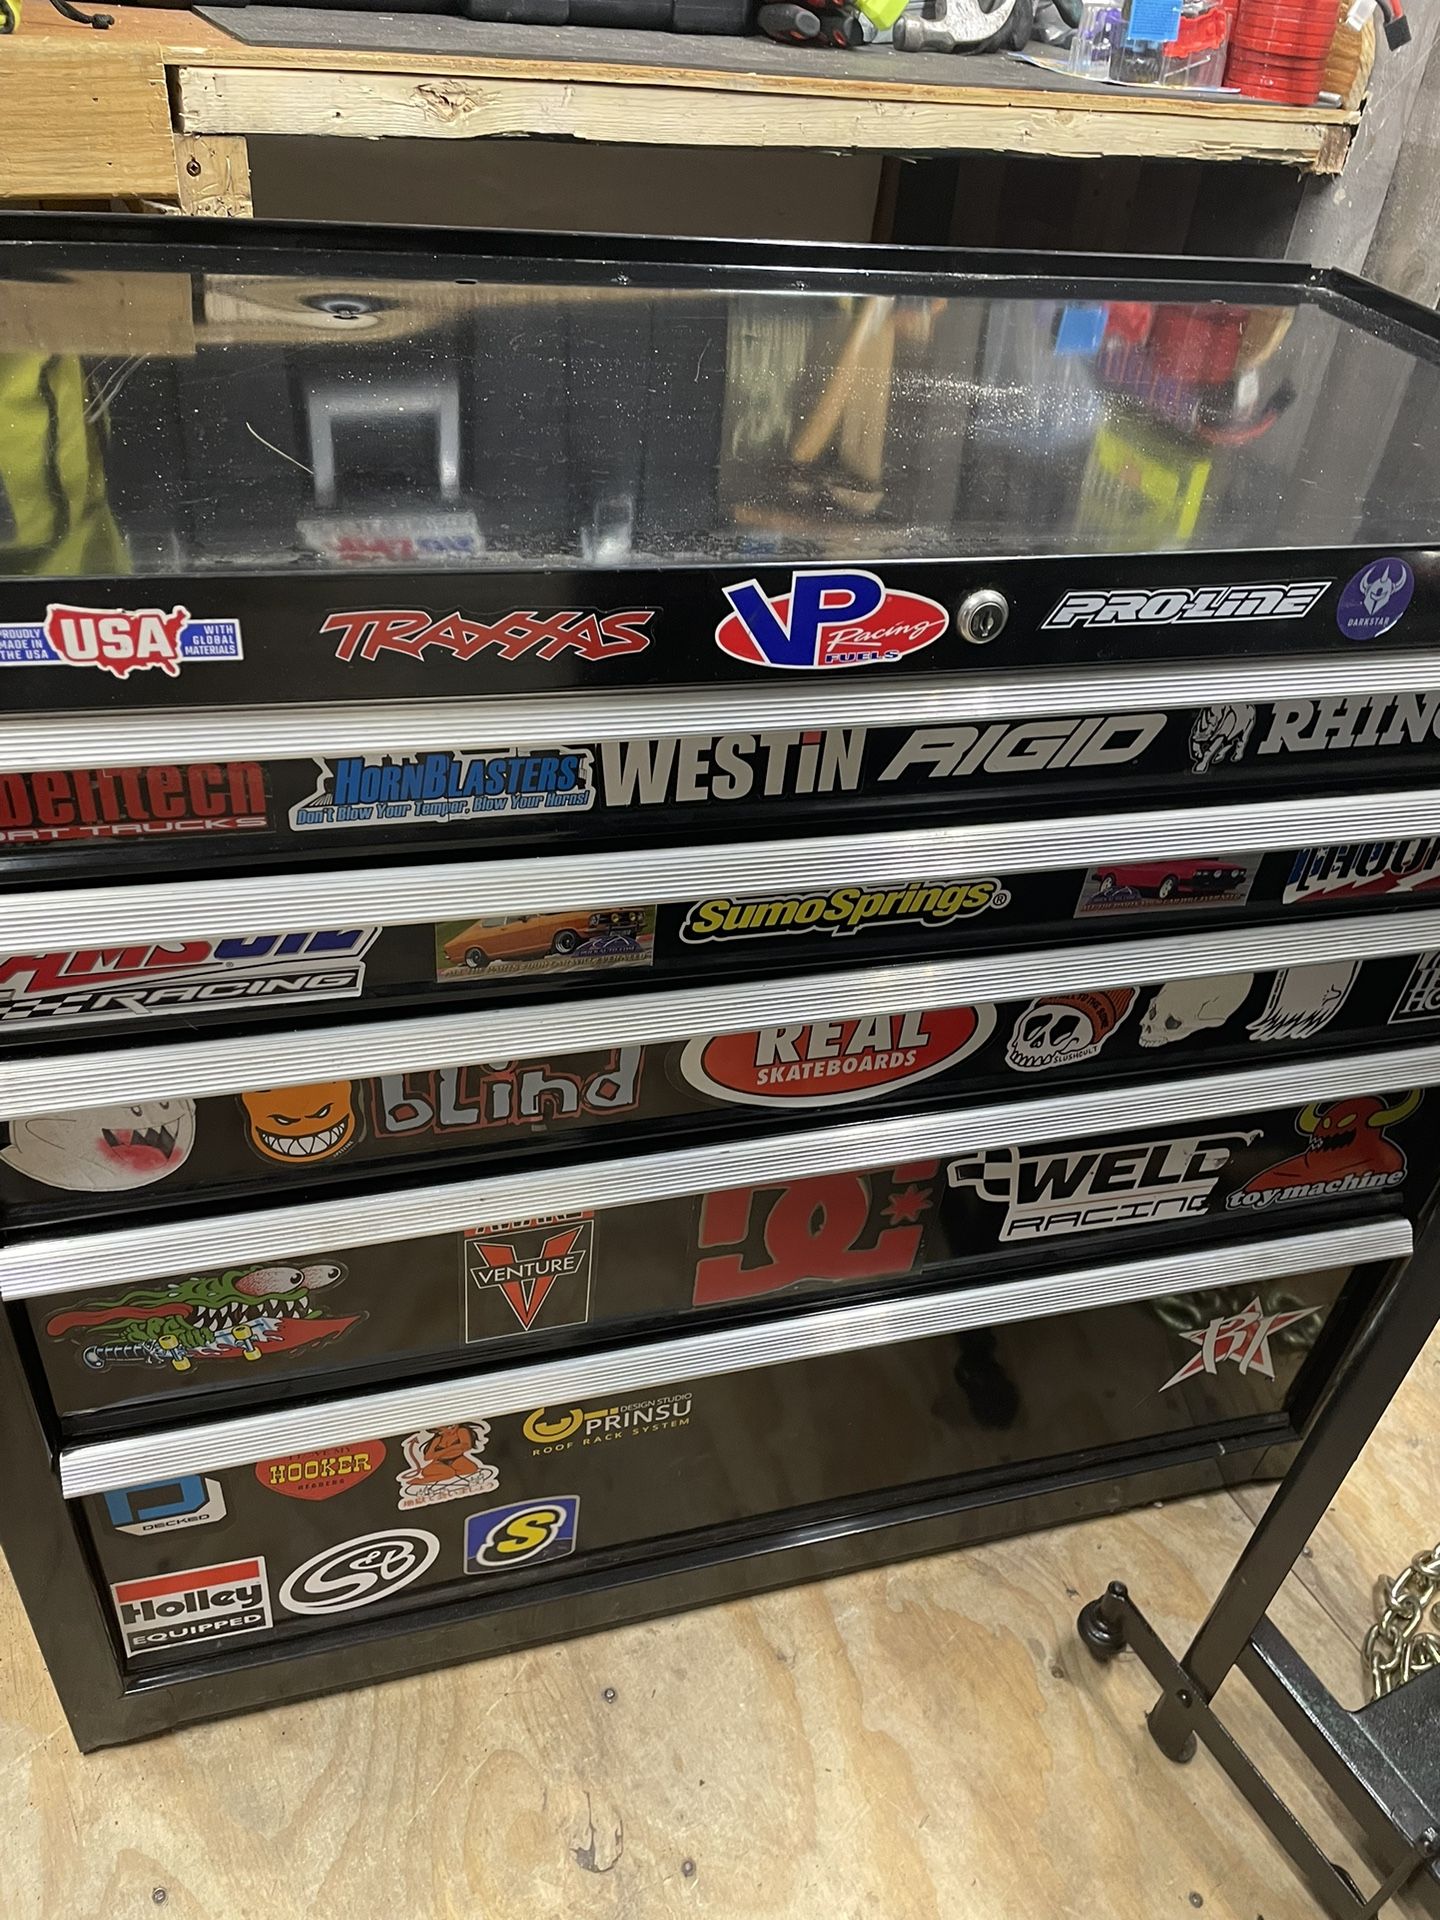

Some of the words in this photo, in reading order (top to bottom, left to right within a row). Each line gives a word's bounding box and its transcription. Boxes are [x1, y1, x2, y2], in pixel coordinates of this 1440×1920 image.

[0, 629, 41, 639] ROUDLY
[203, 624, 234, 635] WITH
[722, 570, 886, 667] VP
[1347, 617, 1390, 627] DARKSTAR
[31, 639, 43, 649] IN
[60, 616, 176, 660] USA
[184, 645, 236, 656] MATERIALS
[192, 635, 235, 646] GLOBAL
[319, 611, 655, 662] TRAXXAS
[827, 619, 945, 653] Racing
[0, 650, 22, 661] THE
[25, 649, 49, 660] USA
[824, 649, 901, 663] FUELS
[1257, 693, 1440, 755] RHIN
[877, 713, 1168, 781] RIGID
[336, 804, 374, 822] Blow
[376, 802, 412, 819] Your
[472, 796, 507, 812] Blow
[510, 793, 544, 810] Your
[544, 788, 590, 807] Horns!
[79, 816, 268, 836] TRUCKS
[90, 973, 357, 1014] RACING
[756, 1012, 929, 1066] REAL
[757, 1050, 917, 1085] SKATEBOARDS
[1053, 1046, 1098, 1064] SLUSHCULT
[479, 1256, 574, 1283] VENTURE
[586, 1400, 691, 1435] PRINSU
[620, 1400, 656, 1413] DESIGN
[657, 1392, 692, 1405] STUDIO
[532, 1442, 573, 1456] ROOF
[583, 1432, 622, 1446] RACK
[632, 1417, 690, 1436] SYSTEM
[270, 1453, 371, 1484] HOOKER
[143, 1513, 209, 1531] DECKED
[121, 1584, 262, 1624] Holley
[133, 1613, 262, 1645] EQUIPPED
